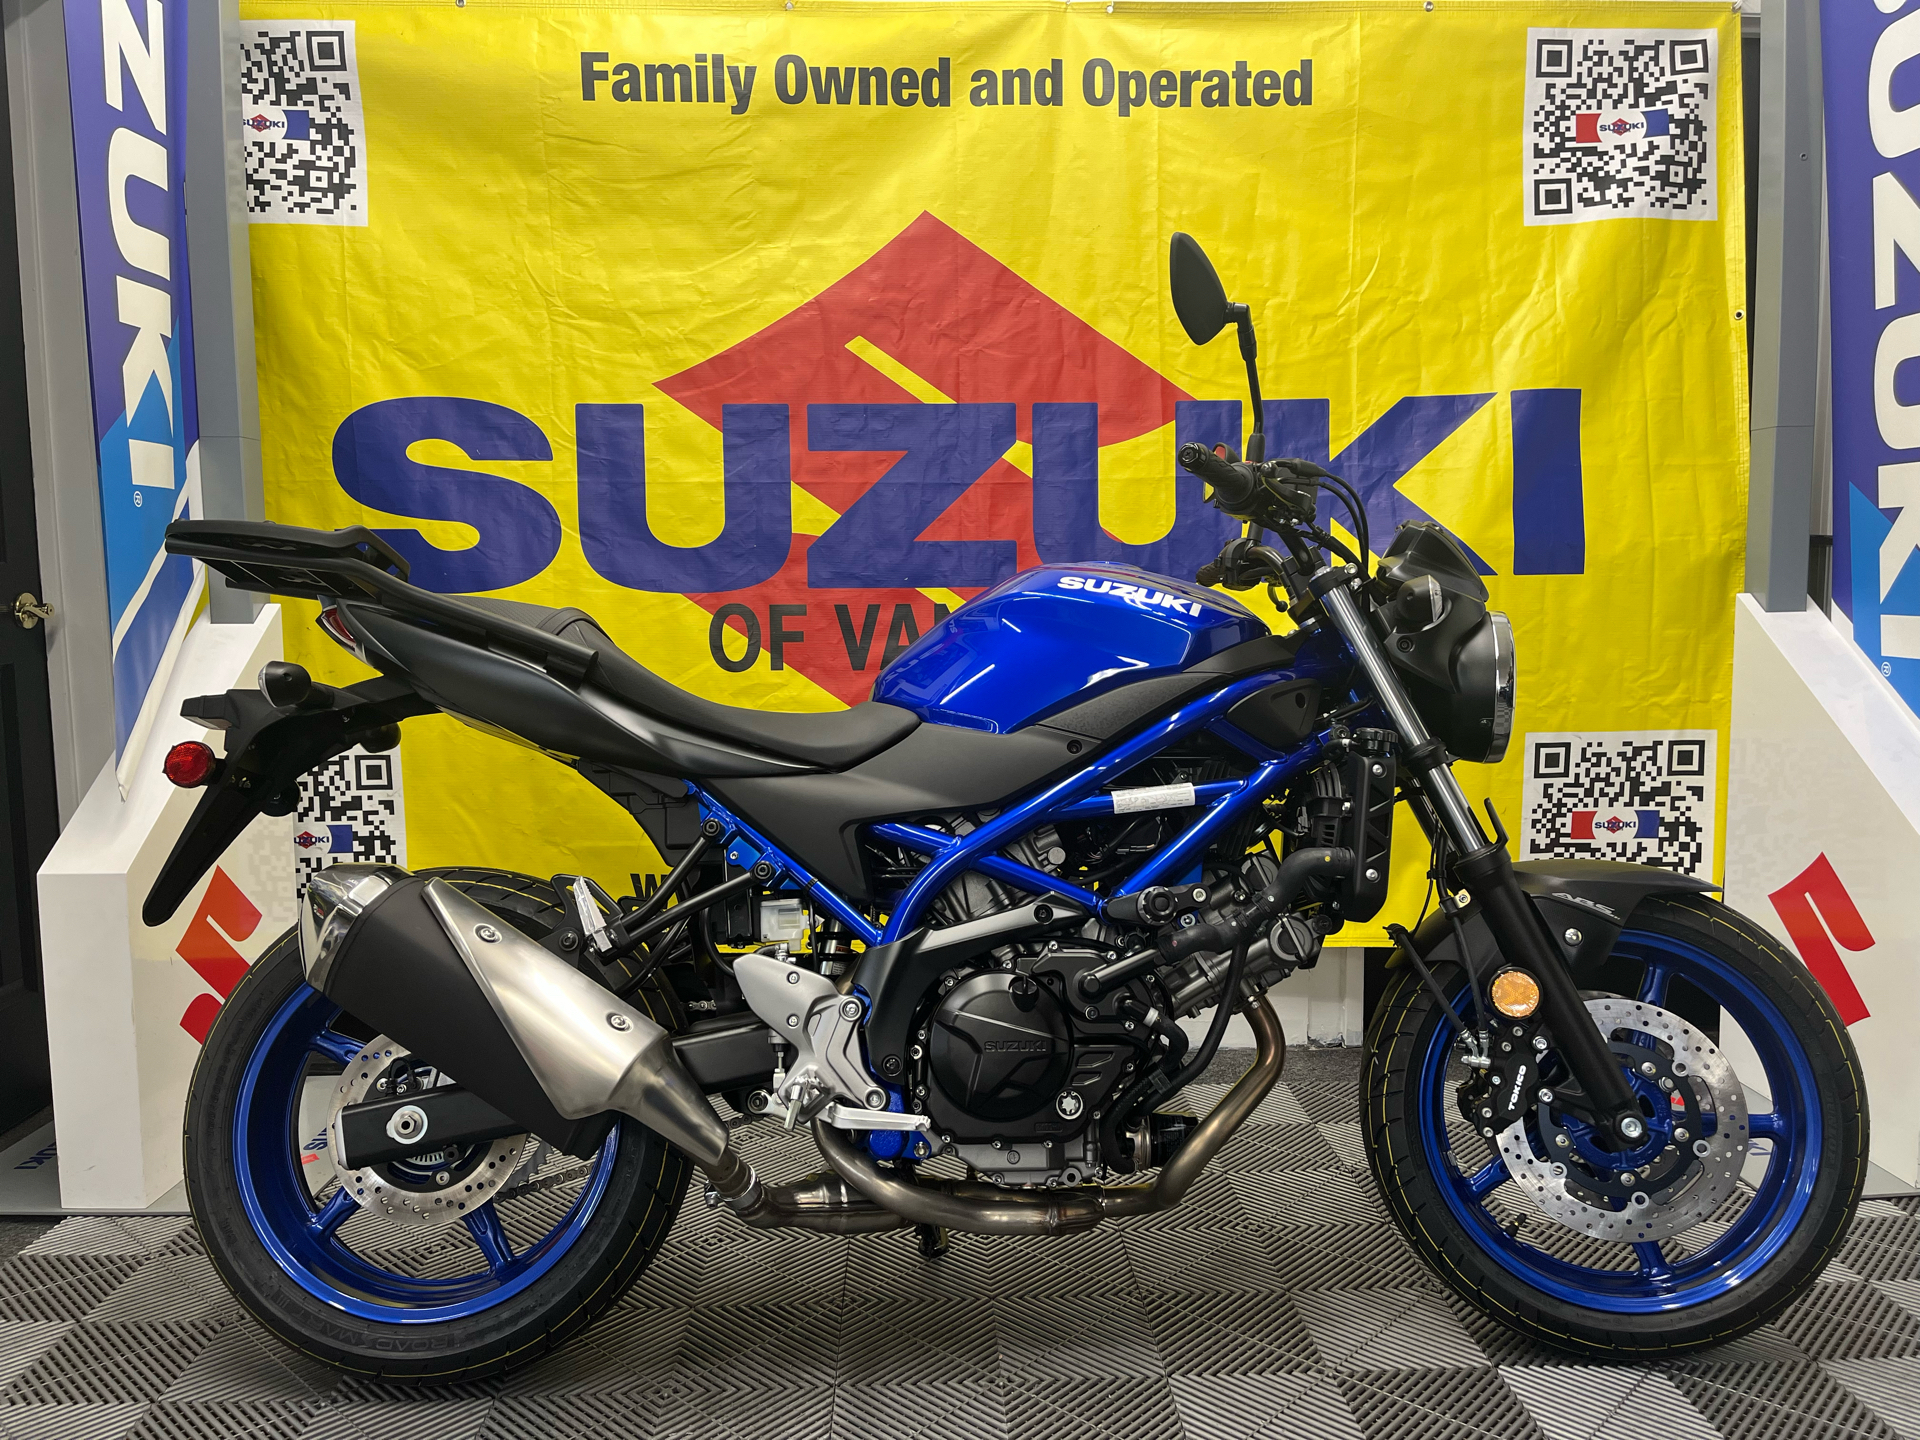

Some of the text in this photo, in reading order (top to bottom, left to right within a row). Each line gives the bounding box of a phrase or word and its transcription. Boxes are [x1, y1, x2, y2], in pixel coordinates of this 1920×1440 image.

[580, 51, 1314, 117] Family Owned and Operated
[1599, 121, 1645, 132] SUZUKI
[331, 387, 1586, 593] SUZUKI
[1057, 576, 1203, 618] SUZUKI
[708, 602, 808, 673] OF
[1594, 820, 1637, 829] SUZUKI
[984, 1040, 1047, 1053] SUZUKI
[1507, 1064, 1527, 1111] TOKICO
